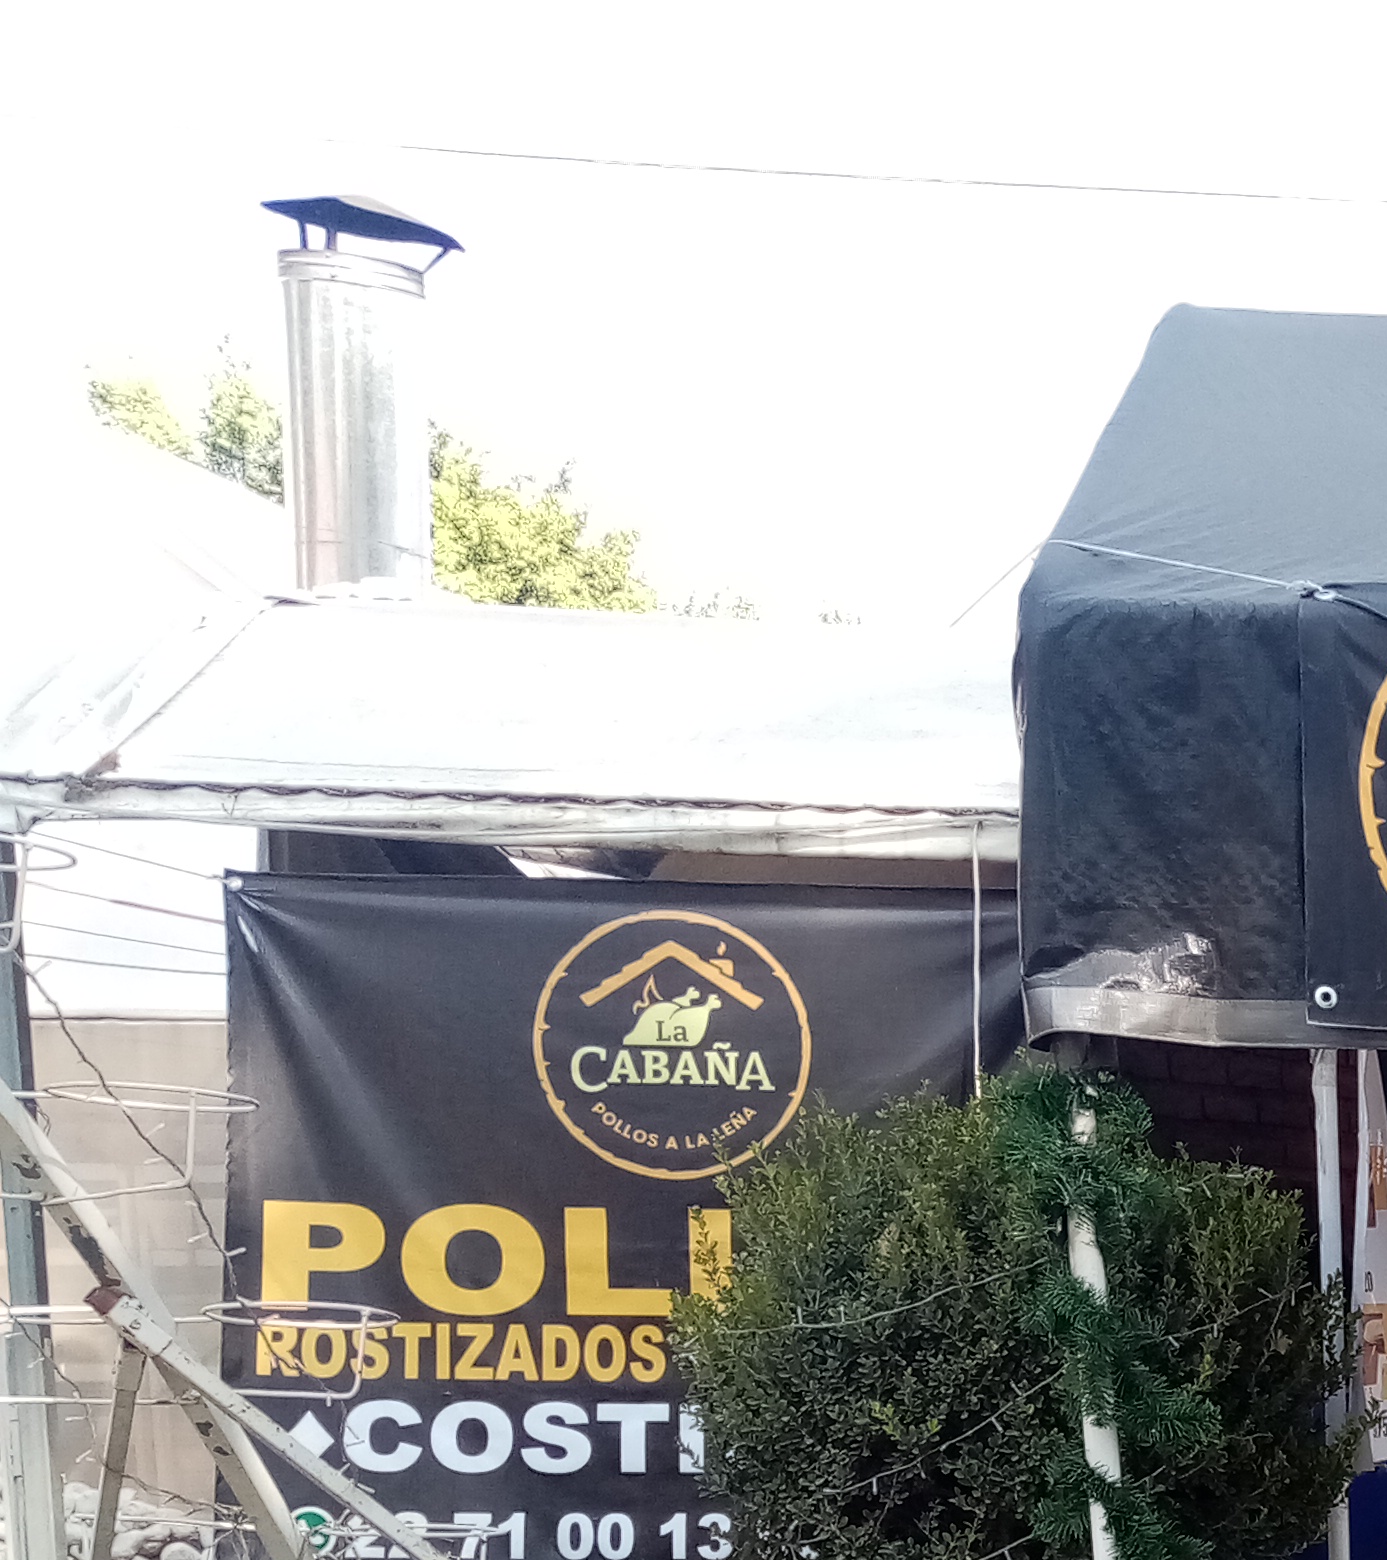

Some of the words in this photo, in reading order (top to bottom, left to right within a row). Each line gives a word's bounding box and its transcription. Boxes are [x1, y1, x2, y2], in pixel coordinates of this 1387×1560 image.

[655, 1020, 689, 1042] La
[571, 1042, 776, 1093] CABAÑA
[590, 1101, 659, 1148] POLLOS
[665, 1135, 679, 1150] A
[685, 1132, 710, 1149] LA
[711, 1106, 758, 1141] LEÑA
[255, 1322, 668, 1383] ROSTIZADOS
[454, 1512, 526, 1560] 71
[557, 1512, 634, 1560] 00
[659, 1512, 734, 1560] 13
